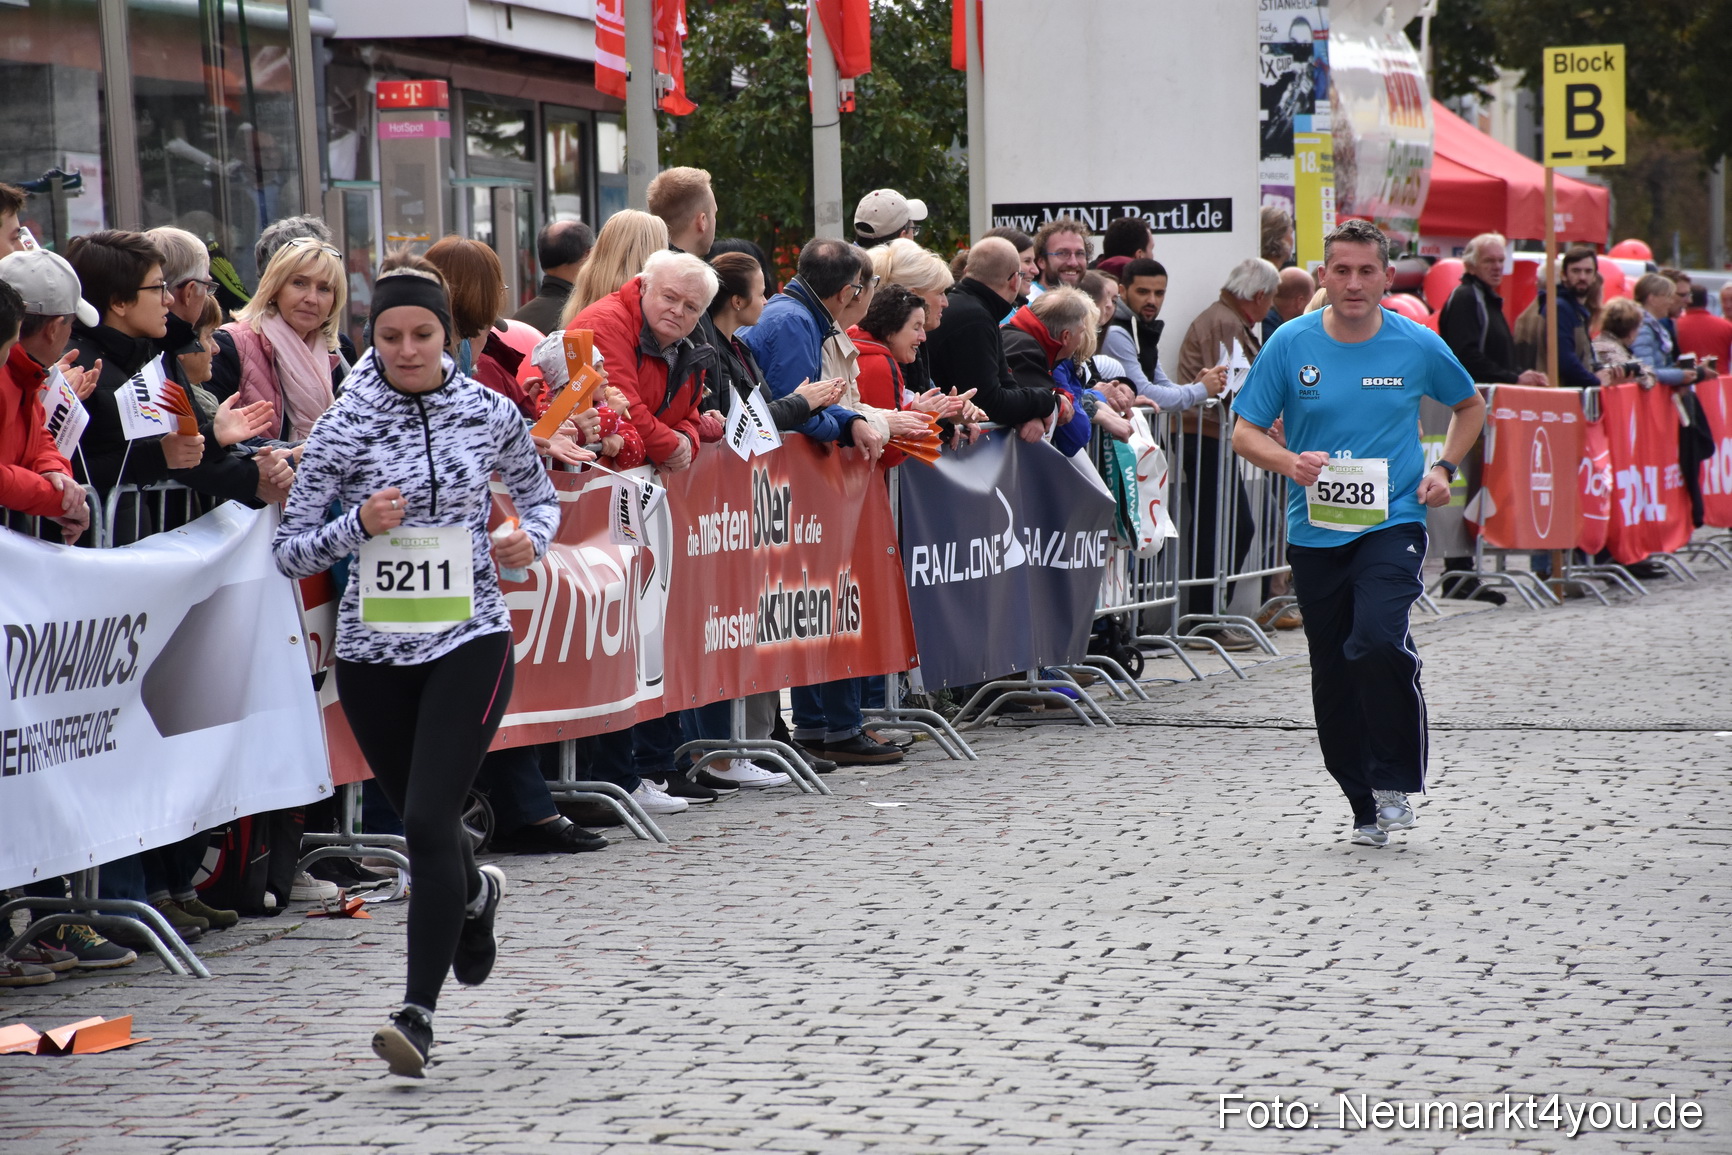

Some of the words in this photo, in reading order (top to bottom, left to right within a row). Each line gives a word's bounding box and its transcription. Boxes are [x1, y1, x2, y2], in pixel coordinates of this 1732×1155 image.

[1553, 51, 1615, 74] Block
[389, 123, 424, 133] HotSpot
[1566, 83, 1605, 140] B
[130, 373, 151, 406] wn
[1361, 377, 1404, 387] BOCK
[48, 402, 69, 438] wn
[733, 413, 748, 448] swn
[620, 486, 631, 526] swn
[640, 483, 654, 511] sw
[752, 466, 791, 549] 80er
[805, 514, 822, 545] die
[1318, 481, 1375, 505] 5238
[401, 537, 440, 547] BOCK
[911, 534, 1001, 587] RAIL.ONE
[1023, 527, 1109, 570] RAIL.ONE
[376, 559, 450, 592] 5211
